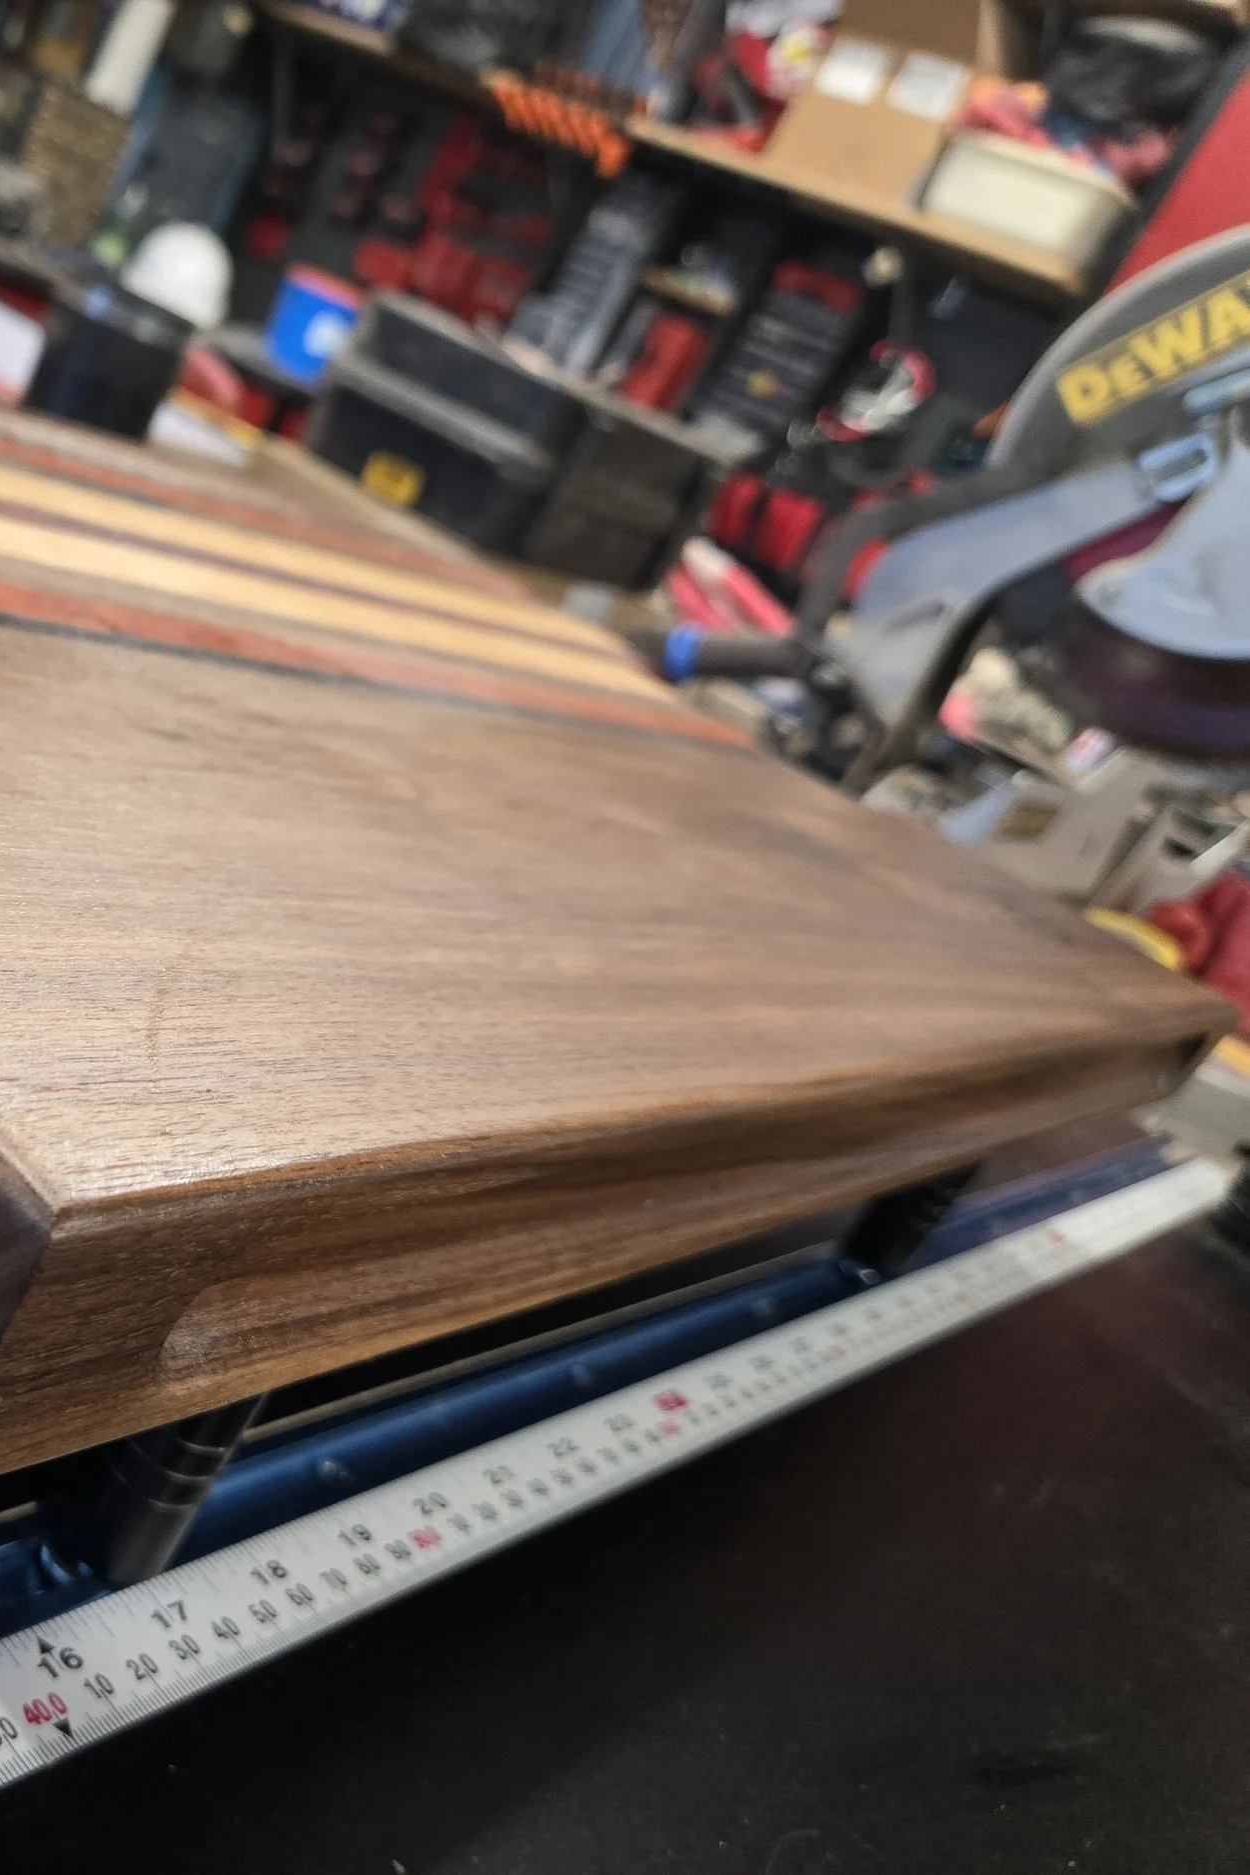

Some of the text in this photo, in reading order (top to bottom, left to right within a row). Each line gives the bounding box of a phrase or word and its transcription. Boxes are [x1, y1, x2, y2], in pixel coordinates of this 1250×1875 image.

[1055, 280, 1250, 427] DEWA
[37, 1646, 84, 1678] 16
[151, 1599, 190, 1629] 17
[250, 1559, 288, 1585] 18
[337, 1523, 372, 1548] 19
[83, 1672, 116, 1700] 10
[125, 1652, 160, 1682] 20
[167, 1633, 201, 1661] 30
[210, 1615, 241, 1641] 40
[249, 1598, 279, 1624] 50
